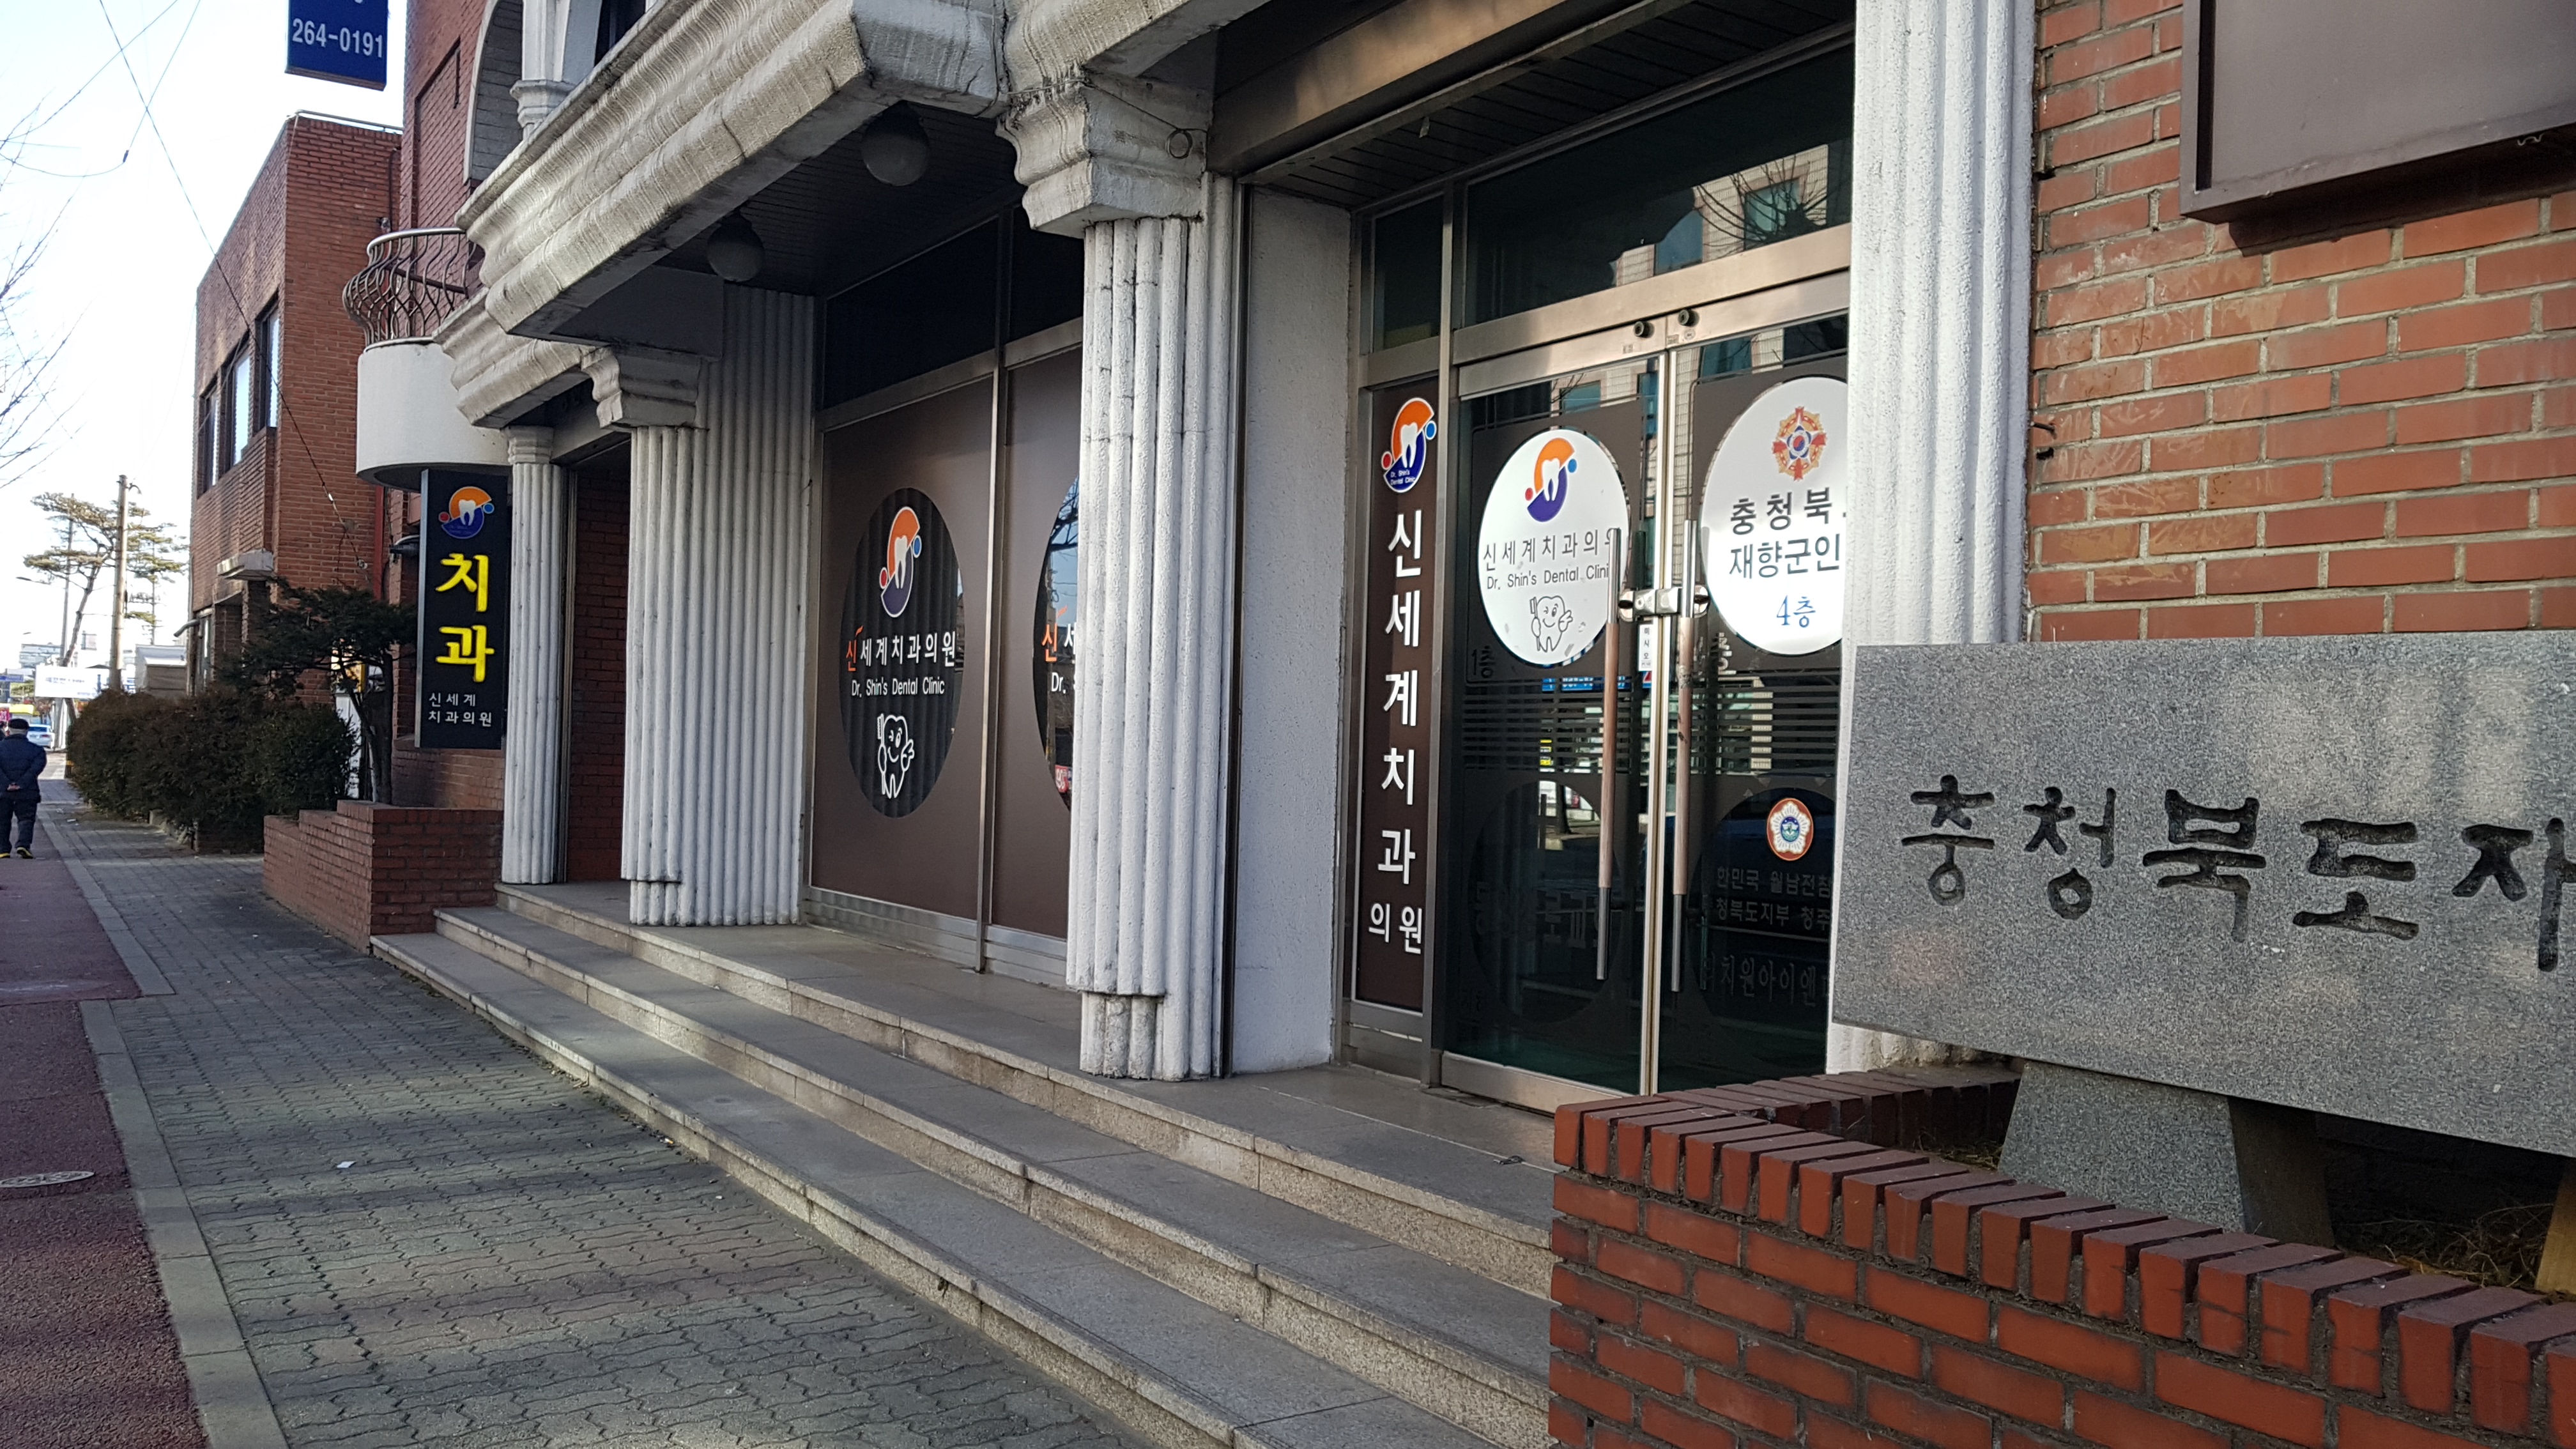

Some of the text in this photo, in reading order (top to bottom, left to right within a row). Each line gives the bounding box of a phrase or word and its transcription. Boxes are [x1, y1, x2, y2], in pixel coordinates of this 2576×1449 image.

[292, 18, 382, 58] 264-0191
[1730, 487, 1846, 535] 충청북
[1729, 533, 1840, 579] 재향군인
[1487, 564, 1609, 590] Dr. Shin's Dental Clini
[436, 553, 494, 682] 치과
[1776, 595, 1816, 627] 4층
[845, 625, 956, 671] 신세계치과의원
[852, 677, 945, 698] Dr. Shin's Dental Clinic
[1051, 672, 1066, 694] Dr.
[429, 693, 475, 707] 신세계
[428, 711, 492, 727] 치과의원
